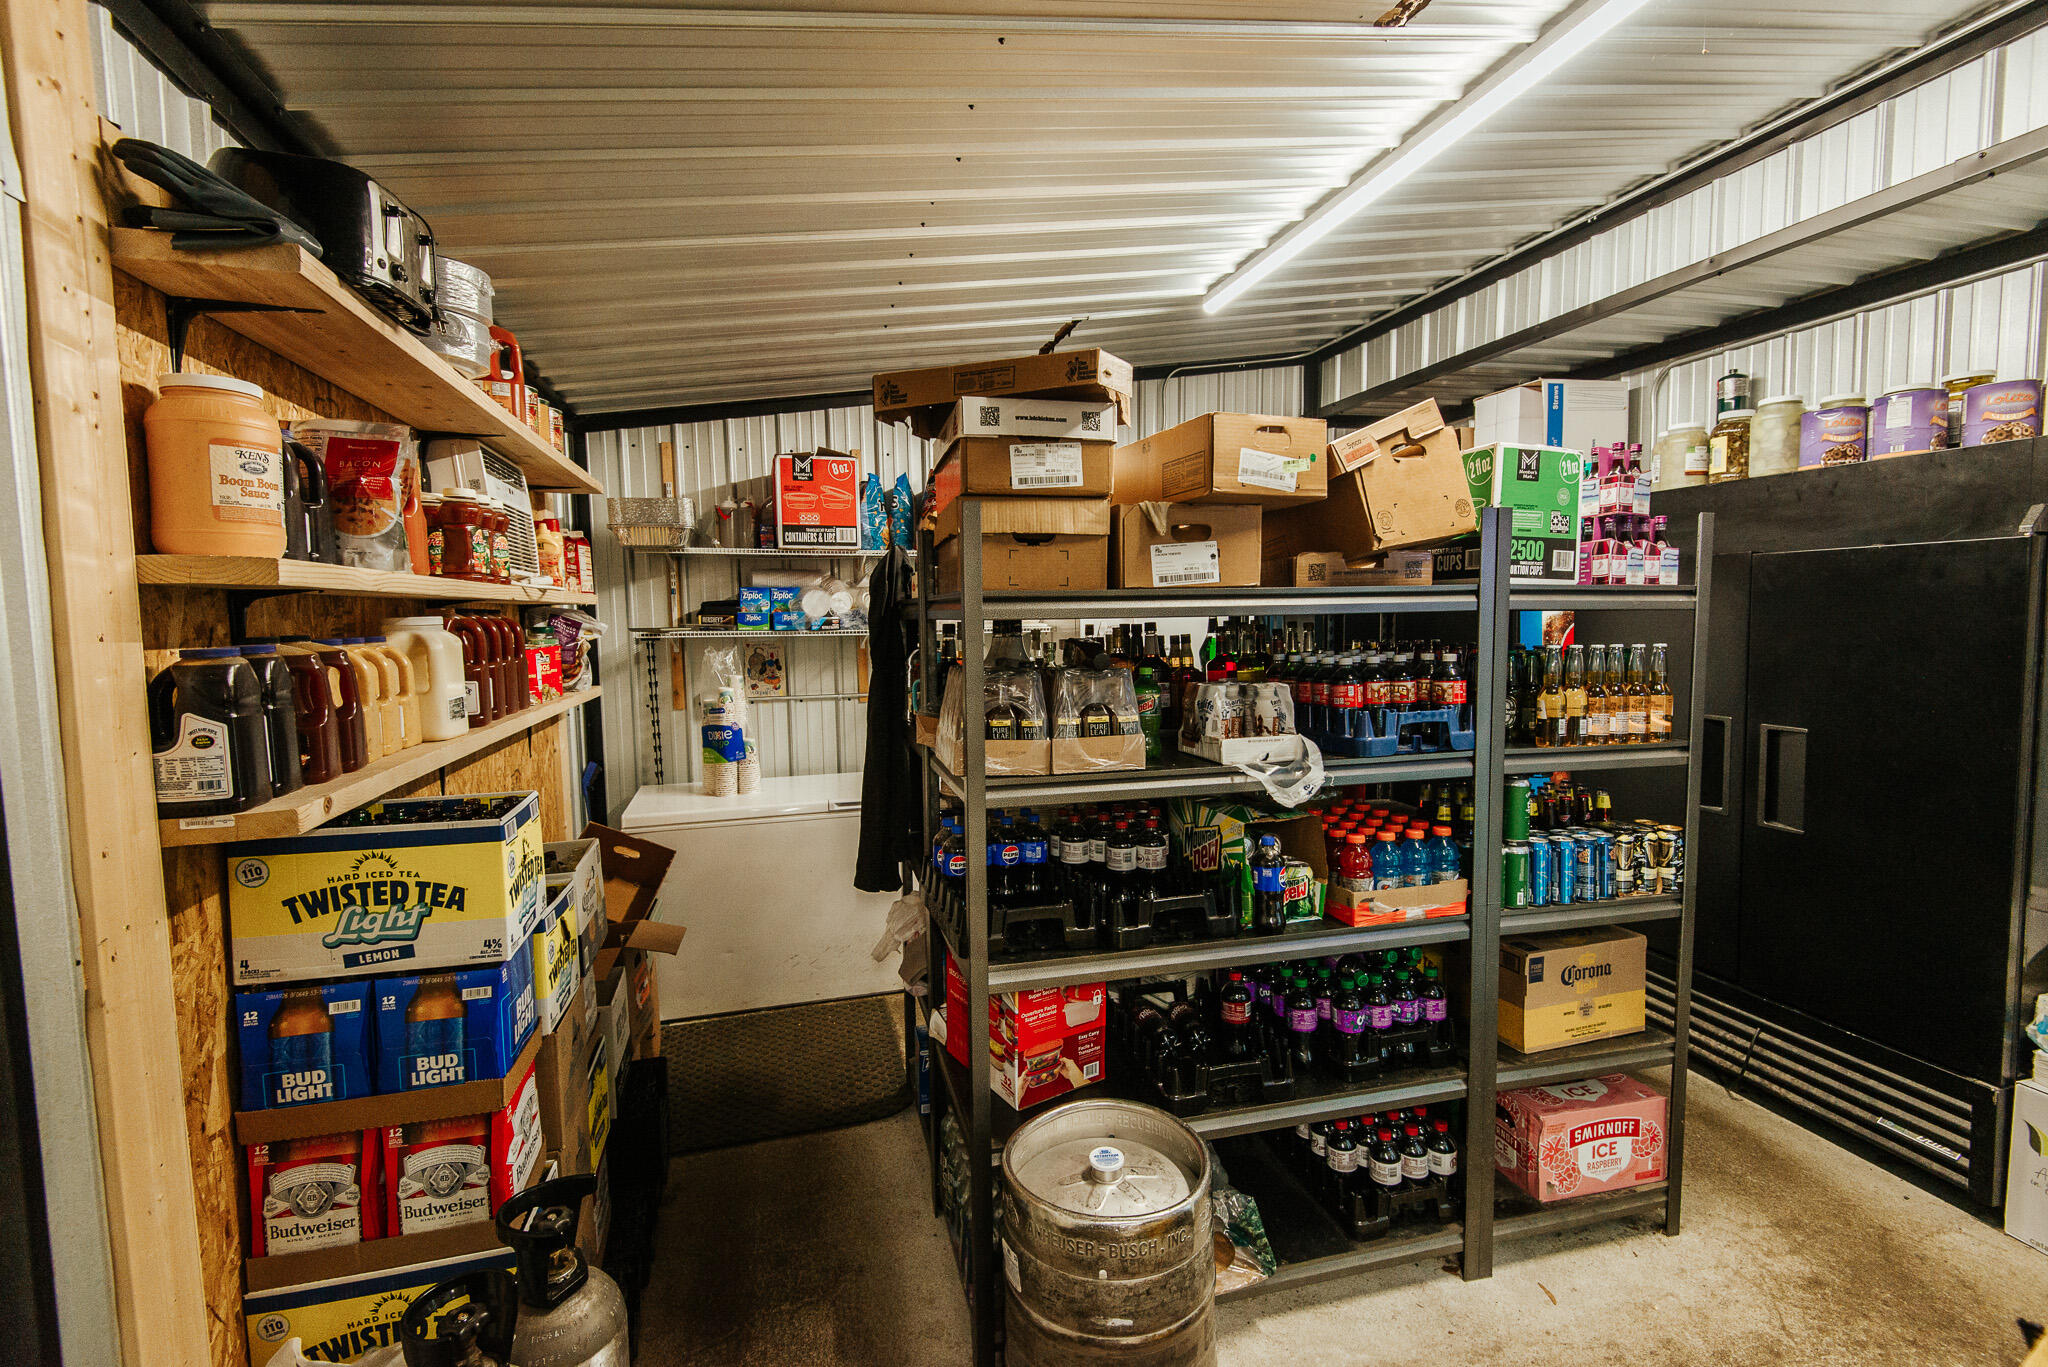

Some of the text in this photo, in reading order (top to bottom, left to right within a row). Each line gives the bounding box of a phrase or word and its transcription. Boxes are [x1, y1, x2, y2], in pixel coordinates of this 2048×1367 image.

[1346, 438, 1362, 450] Sysco
[339, 460, 381, 468] BACON
[831, 463, 849, 475] 8 oz
[1469, 462, 1476, 479] 2
[1481, 457, 1492, 473] oz
[1561, 461, 1567, 477] 2
[1571, 461, 1579, 474] oz
[218, 474, 254, 487] Boom
[240, 486, 270, 499] Sauce
[784, 531, 817, 543] CONTAINERS
[818, 532, 823, 543] &
[1510, 539, 1545, 561] 2500
[1436, 555, 1463, 572] CUPS
[1509, 564, 1544, 576] ORTION CUPS
[741, 592, 763, 600] Ziploc
[773, 591, 793, 600] Ziploc
[745, 614, 762, 622] Ziploc
[992, 726, 1010, 734] PURE
[1023, 726, 1041, 734] PURE
[241, 866, 263, 879] 110
[326, 871, 421, 884] HARD ICED TEA
[509, 858, 534, 909] TWISTED
[281, 880, 467, 924] TWISTED TEA
[323, 903, 432, 947] Light
[483, 938, 503, 949] 4%
[358, 948, 400, 965] LEMON
[240, 960, 249, 970] 4
[1561, 963, 1612, 987] Corona
[1028, 992, 1042, 1000] Super
[1259, 986, 1271, 997] Cru
[381, 995, 396, 1006] 12
[516, 983, 532, 1016] BUD
[243, 1011, 258, 1021] 12
[514, 999, 534, 1046] LIGHT
[1024, 1015, 1039, 1023] Super
[1078, 1030, 1100, 1041] Easy Carry
[416, 1053, 458, 1071] BUD
[281, 1070, 327, 1088] BUD
[411, 1066, 464, 1086] LIGHT
[1002, 1074, 1012, 1087] 32
[276, 1082, 333, 1104] LIGHT
[1561, 1084, 1598, 1098] ICE
[388, 1127, 403, 1138] 12
[1574, 1120, 1636, 1144] SMIRNOFF
[254, 1144, 269, 1155] 12
[1592, 1141, 1619, 1159] ICE
[1587, 1156, 1623, 1171] RASPBERRY
[404, 1196, 486, 1219] Budweiser
[270, 1218, 356, 1240] Budweiser
[1167, 1228, 1192, 1248] INC.
[263, 1320, 283, 1334] 110
[346, 1315, 380, 1329] HARD
